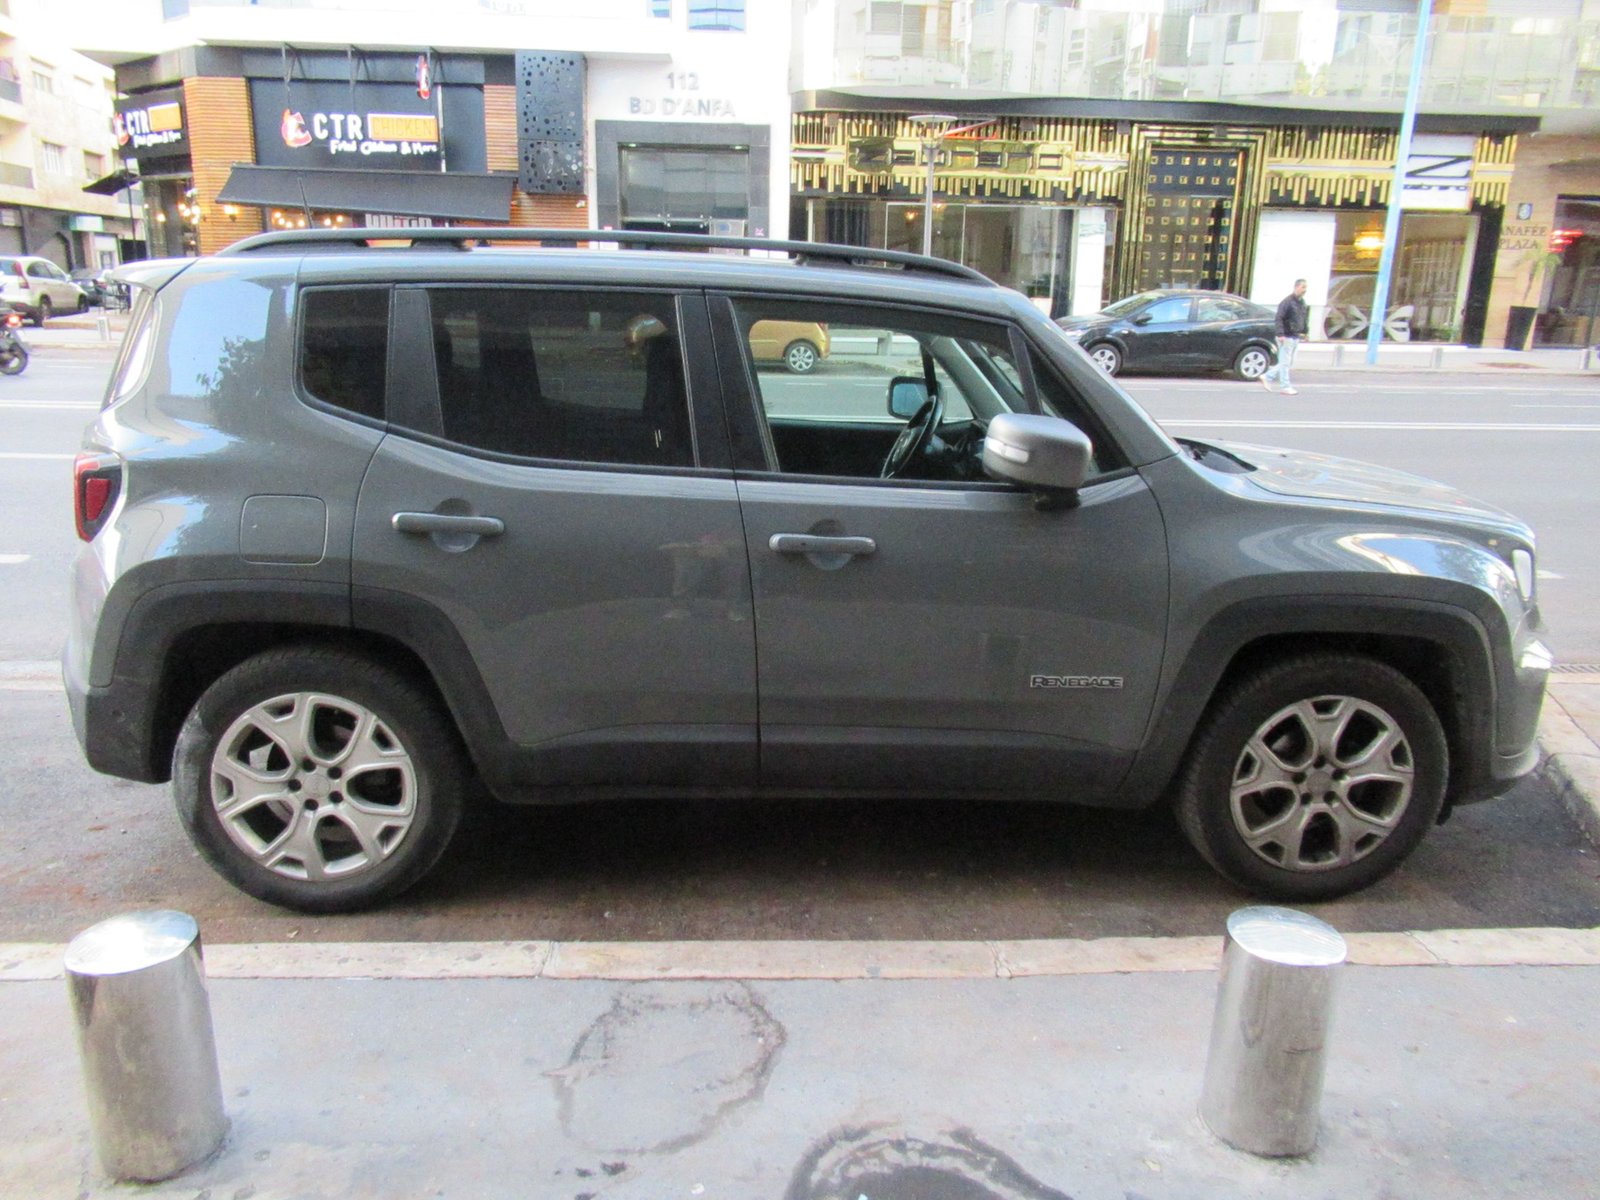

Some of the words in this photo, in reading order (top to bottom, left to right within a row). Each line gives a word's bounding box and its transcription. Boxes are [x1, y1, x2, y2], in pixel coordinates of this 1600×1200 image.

[667, 72, 699, 90] 112
[629, 97, 656, 114] BD
[663, 98, 735, 117] D'ANFA
[126, 110, 149, 135] CTR
[313, 113, 363, 140] CTR
[372, 118, 434, 137] CHICKEN
[1030, 675, 1123, 689] RENEGADE
